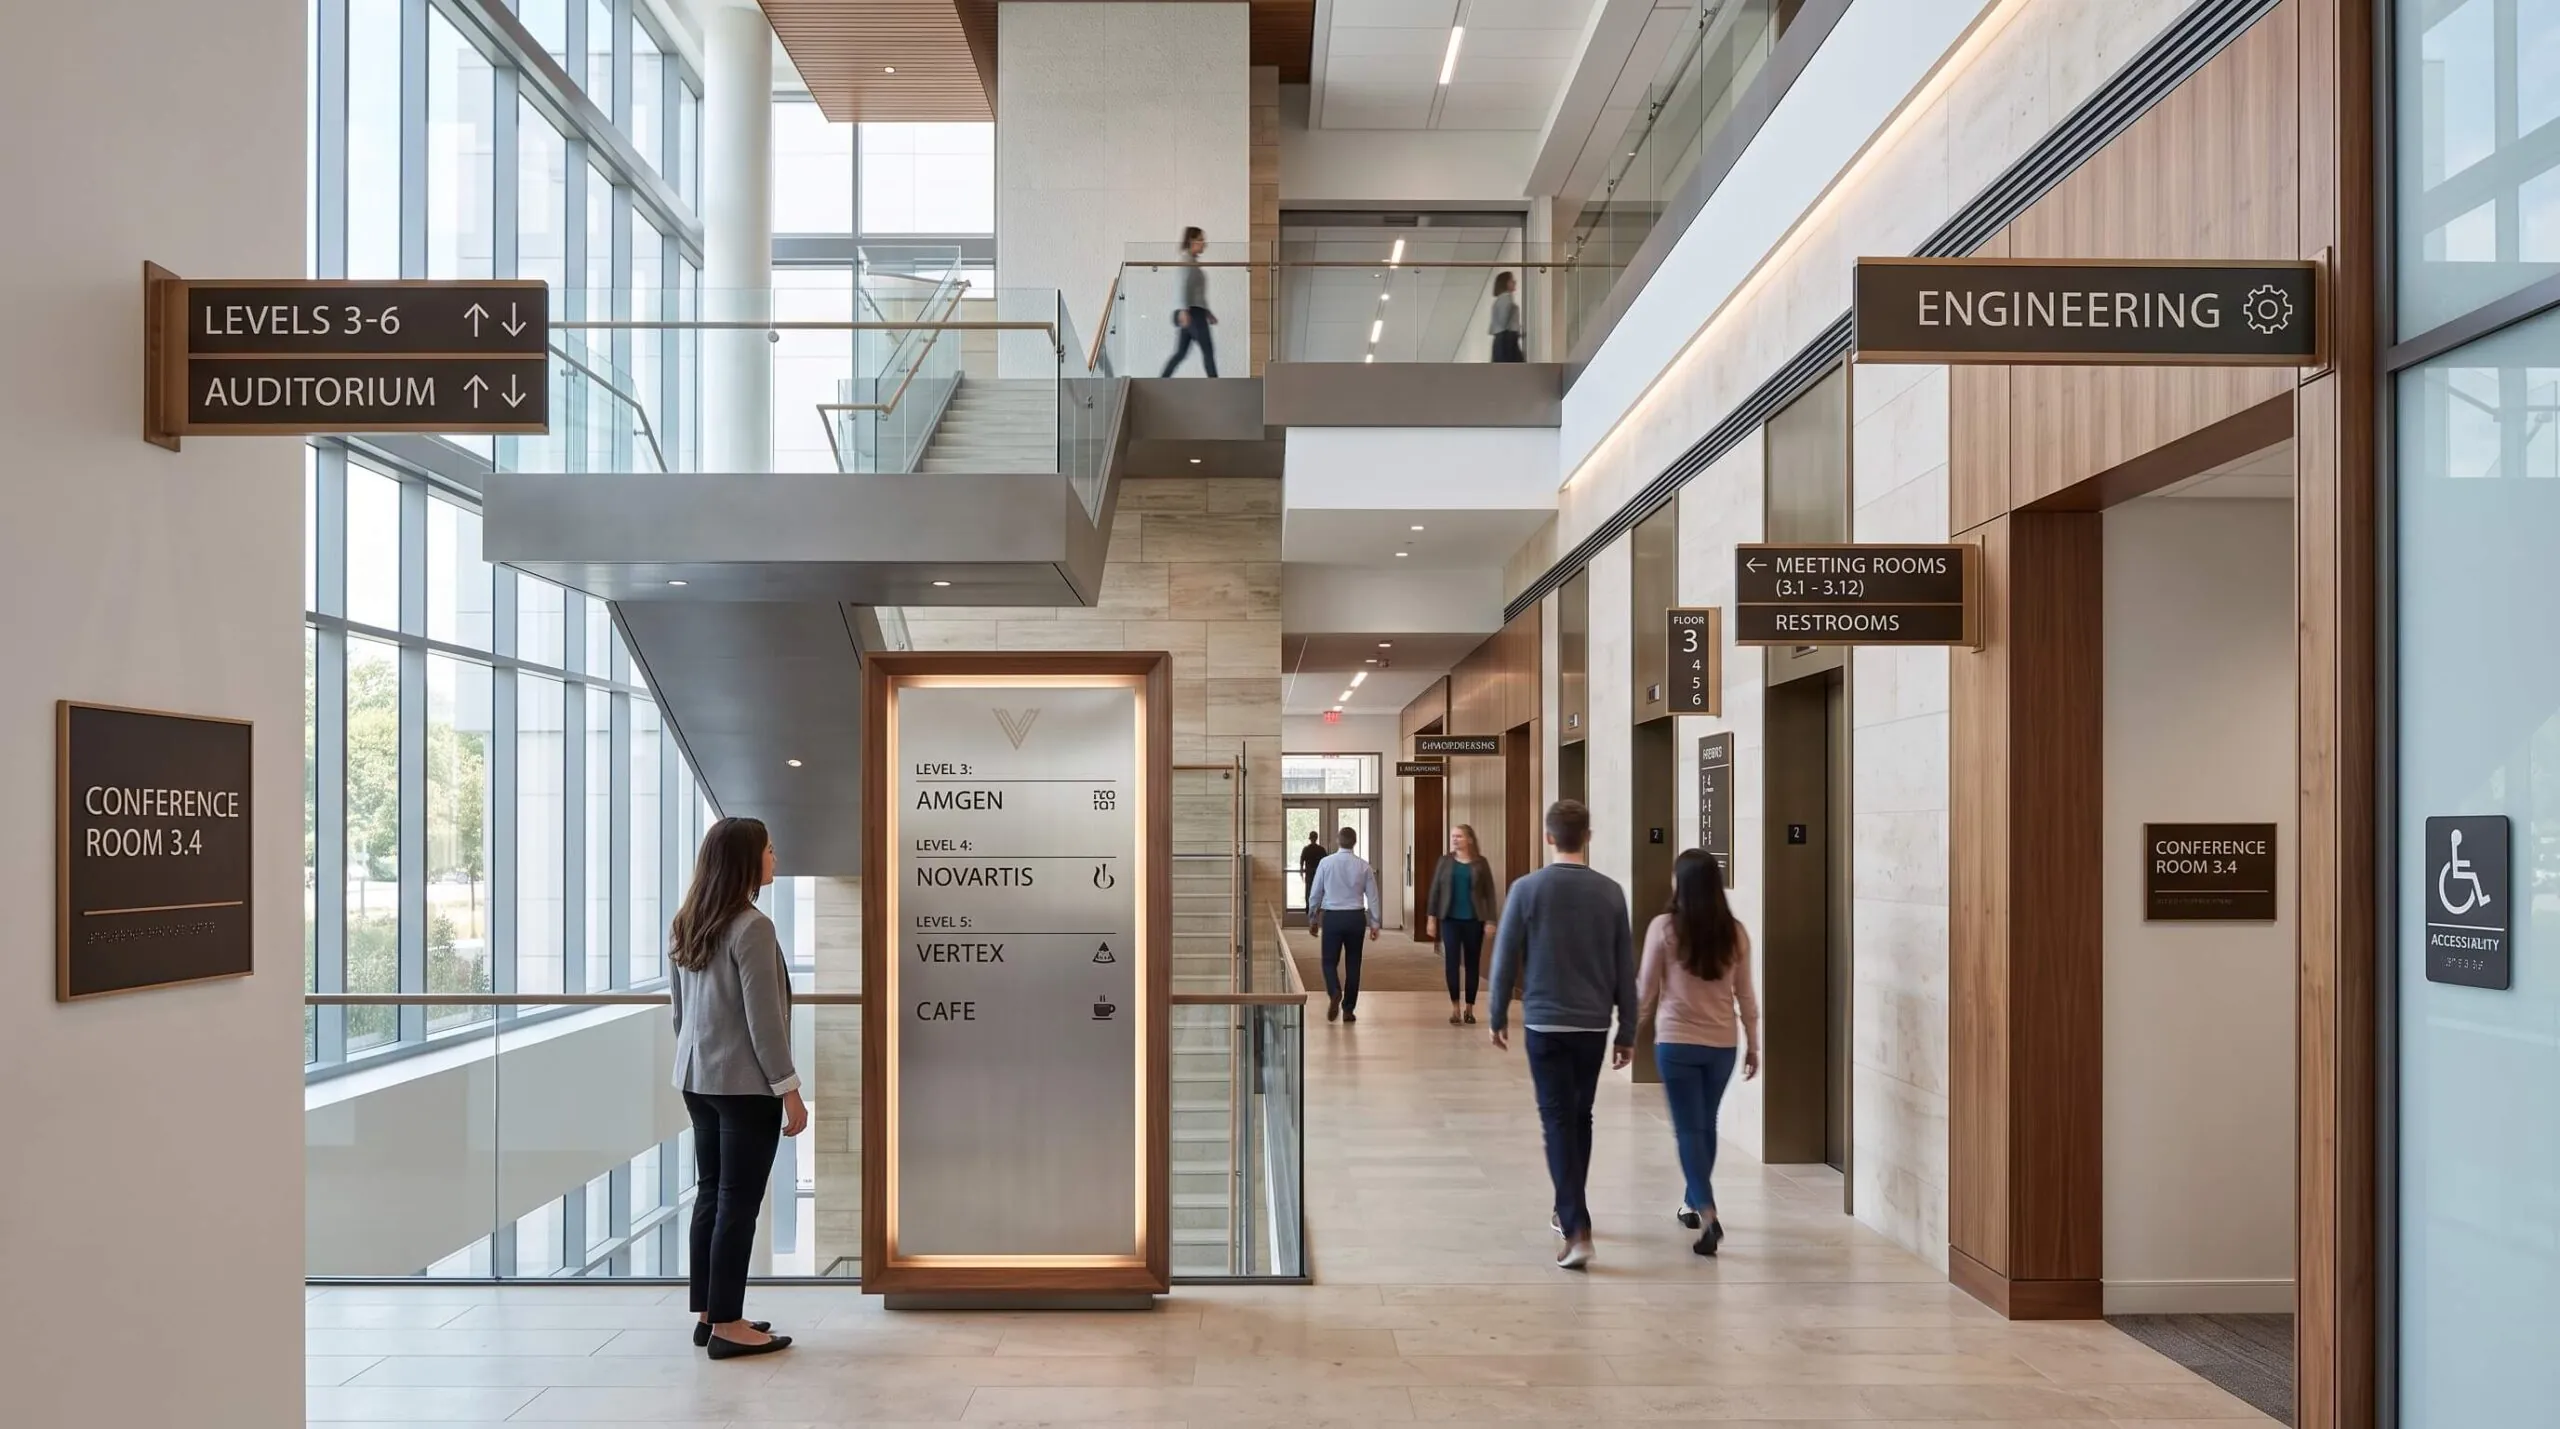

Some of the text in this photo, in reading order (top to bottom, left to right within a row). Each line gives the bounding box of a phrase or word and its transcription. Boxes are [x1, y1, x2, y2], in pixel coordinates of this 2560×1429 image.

[1919, 290, 2220, 328] ENGINEERING
[206, 305, 400, 335] LEVELS 3-6
[204, 377, 435, 407] AUDITORIUM
[1776, 557, 1947, 574] MEETING ROOMS
[1776, 579, 1804, 598] (3.1
[1823, 579, 1864, 598] 3.12)
[1673, 616, 1705, 625] FLOOR
[1776, 614, 1900, 631] RESTROOMS
[1683, 629, 1698, 653] 3
[1692, 659, 1701, 671] 4
[1692, 676, 1701, 689] 5
[1692, 693, 1702, 706] 6
[916, 763, 972, 775] LEVEL 3:
[86, 786, 239, 818] CONFERENCE
[916, 790, 1003, 810] AMGEN
[1793, 826, 1801, 839] 2
[86, 828, 203, 857] ROOM 3.4
[916, 839, 972, 851] LEVEL 4:
[2155, 840, 2266, 855] CONFERENCE
[2156, 859, 2238, 874] ROOM 3.4
[917, 867, 1033, 887] NOVARTIS
[916, 915, 972, 928] LEVEL 5:
[916, 943, 1004, 963] VERTEX
[916, 1001, 976, 1021] CAFE
